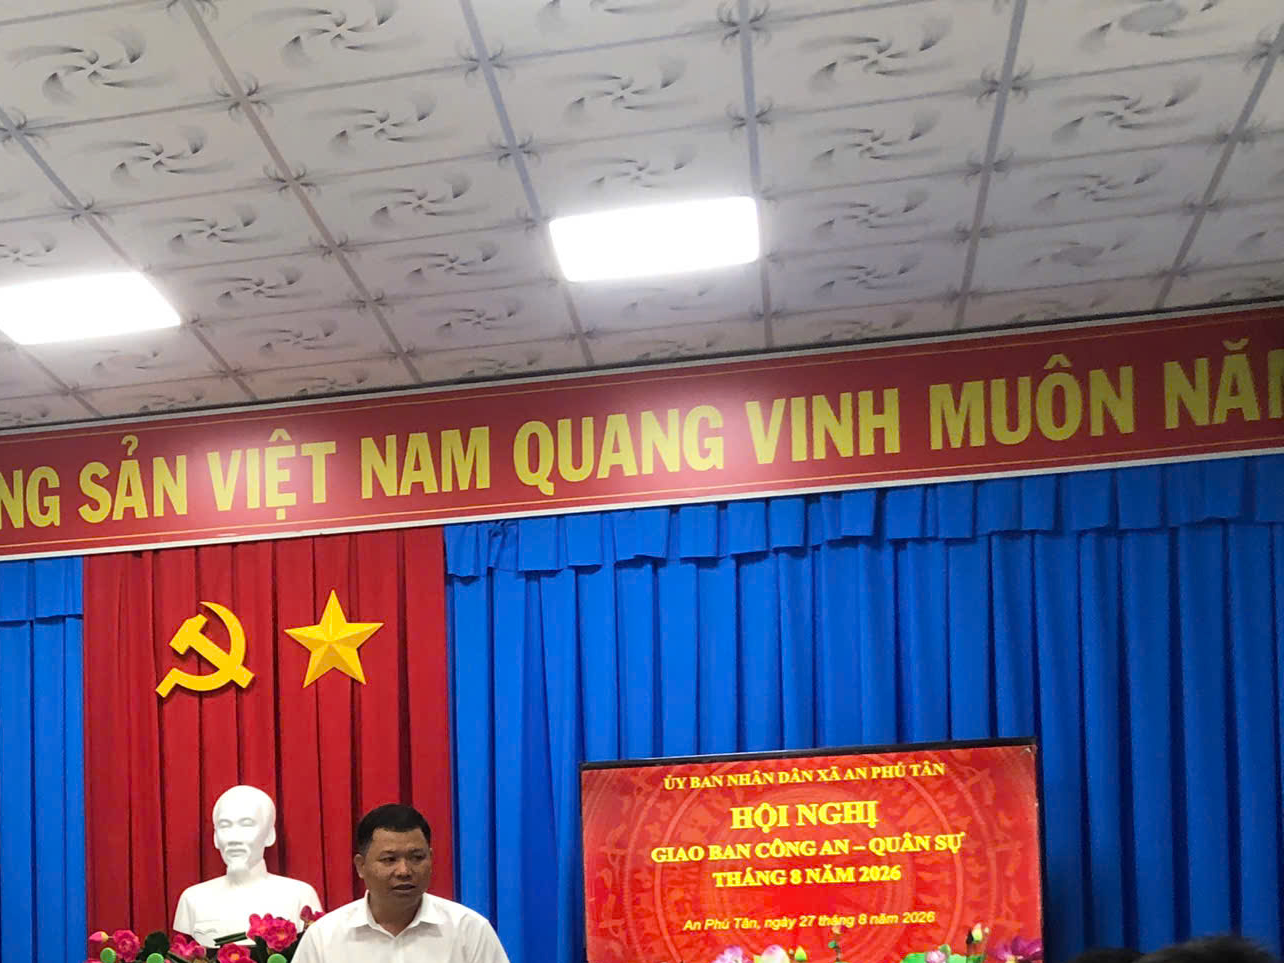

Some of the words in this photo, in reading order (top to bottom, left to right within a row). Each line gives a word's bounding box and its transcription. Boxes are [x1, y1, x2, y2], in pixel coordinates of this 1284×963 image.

[78, 434, 187, 522] SẢN
[206, 428, 337, 519] VIỆT
[361, 426, 491, 499] NAM
[512, 405, 724, 497] QUANG
[745, 387, 901, 464] VINH
[929, 353, 1135, 451] MUÔN
[664, 774, 686, 790] ỦY
[690, 775, 723, 789] BAN
[727, 769, 775, 787] NHÂN
[778, 767, 814, 784] DÂN
[817, 766, 842, 782] XÃ
[843, 767, 868, 781] AN
[871, 762, 906, 779] PHÚ
[910, 760, 945, 777] TÂN
[730, 803, 789, 833] HỘI
[796, 801, 878, 828] NGHỊ
[651, 845, 704, 863] GIAO
[708, 843, 751, 860] BAN
[754, 838, 816, 858] CÔNG
[820, 839, 849, 855] AN
[868, 832, 930, 854] QUÂN
[935, 832, 965, 854] SỰ
[713, 867, 786, 887] THÁNG
[790, 869, 801, 885] 8
[805, 864, 855, 883] NĂM
[859, 865, 901, 882] 2026
[684, 919, 701, 931] An
[704, 918, 729, 930] Phú
[764, 916, 796, 931] ngày
[799, 915, 816, 927] 27
[818, 914, 854, 929] tháng
[858, 914, 867, 925] 8
[870, 913, 898, 925] năm
[902, 911, 935, 924] 2026
